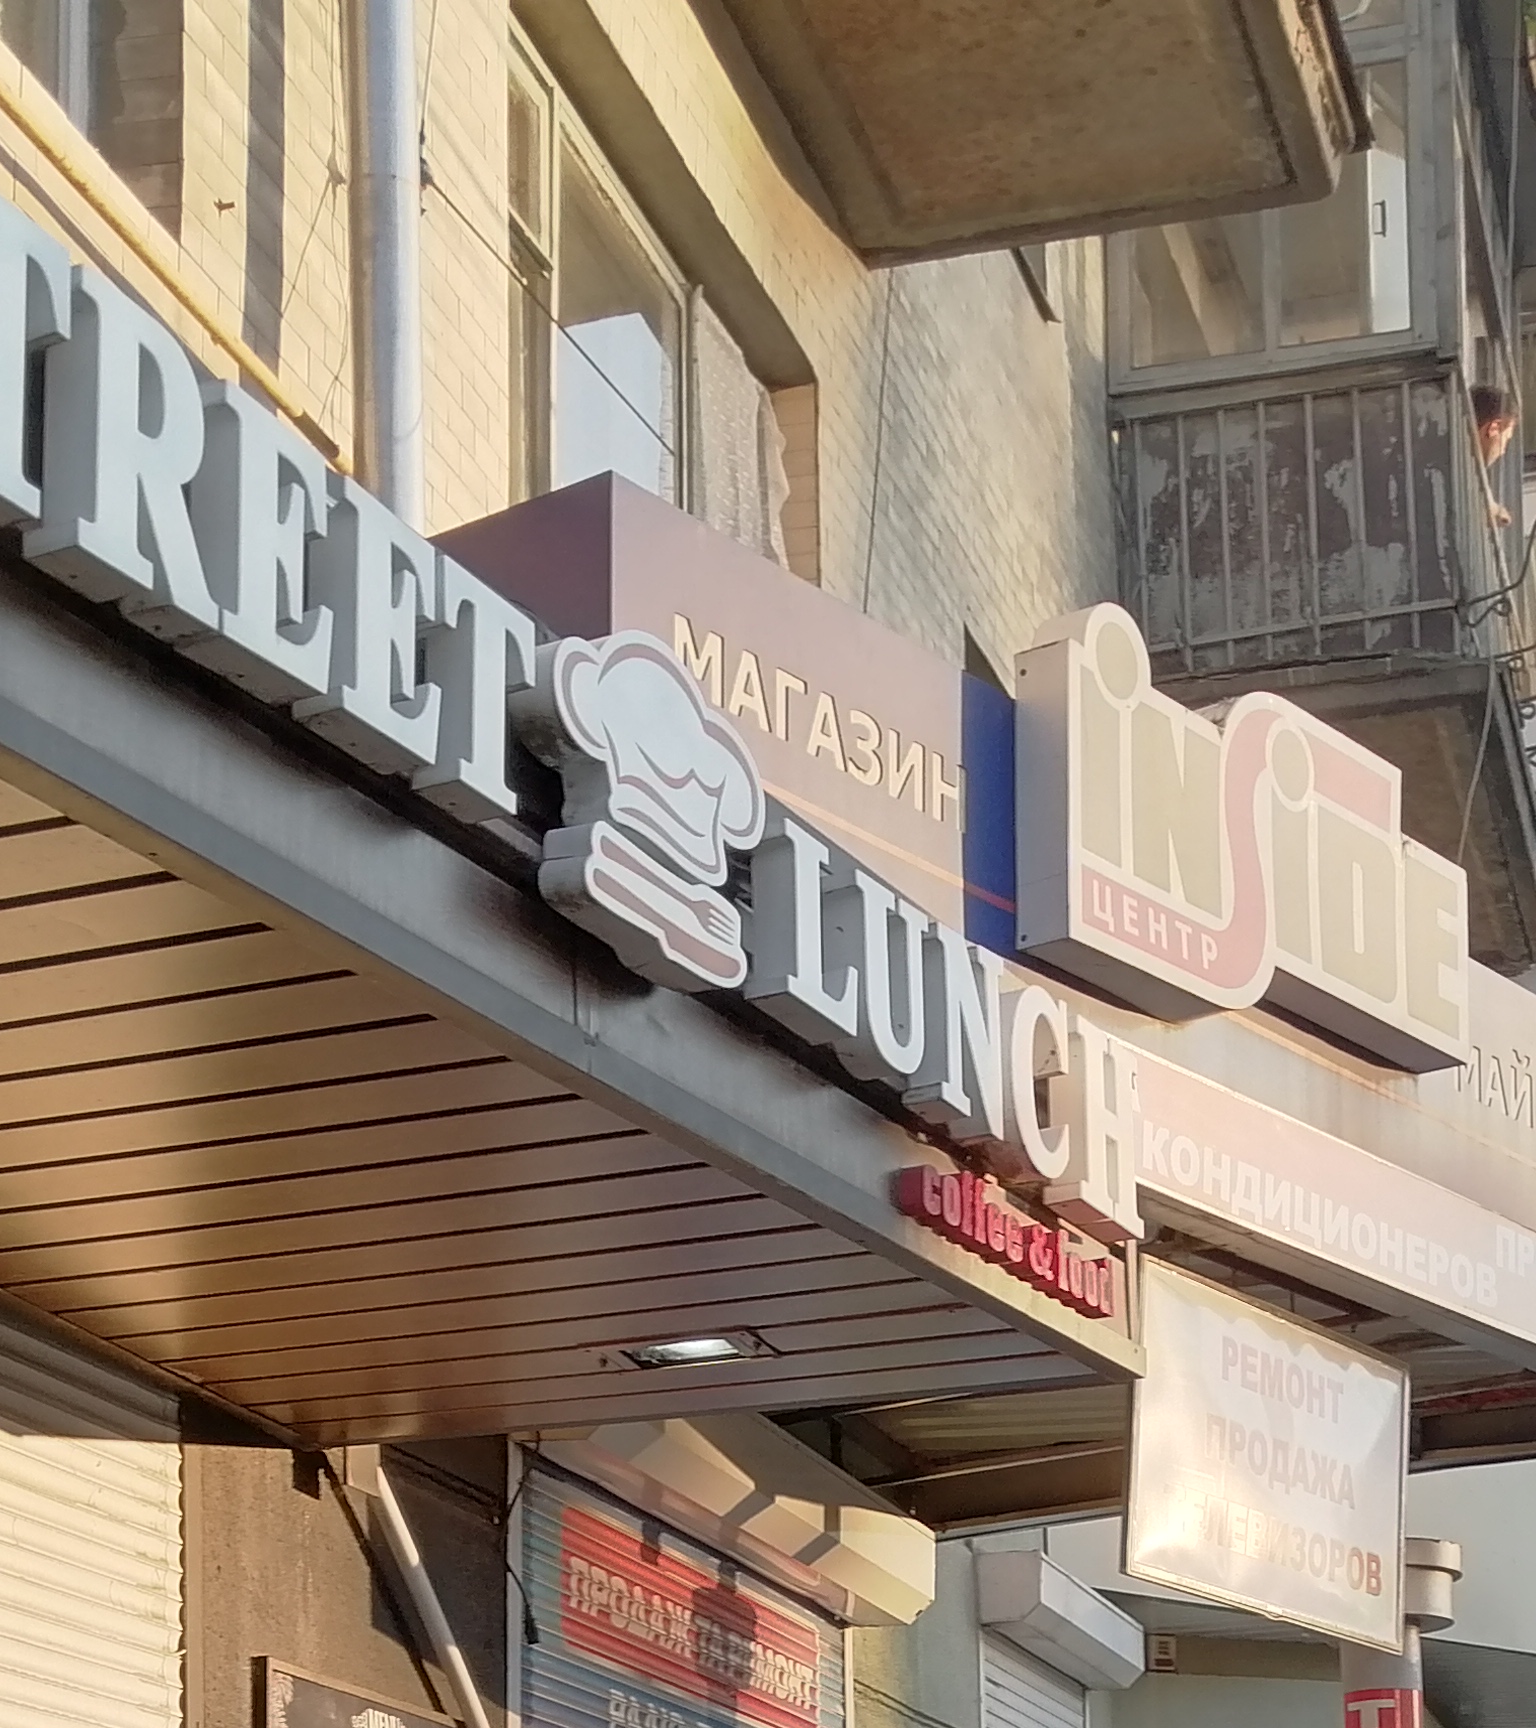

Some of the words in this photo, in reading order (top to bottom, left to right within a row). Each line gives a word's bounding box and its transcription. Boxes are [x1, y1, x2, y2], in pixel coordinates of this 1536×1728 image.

[673, 612, 964, 832] МАГАЗИН
[1090, 876, 1219, 972] ЦЕНТР
[782, 818, 1145, 1240] LUNCH
[1141, 1124, 1498, 1308] КОНДИЦИОНЕРОВ
[1220, 1335, 1345, 1424] РЕМОНТ
[1205, 1412, 1356, 1510] ПРОДАЖА
[568, 1556, 693, 1658] ПРОДАЖ
